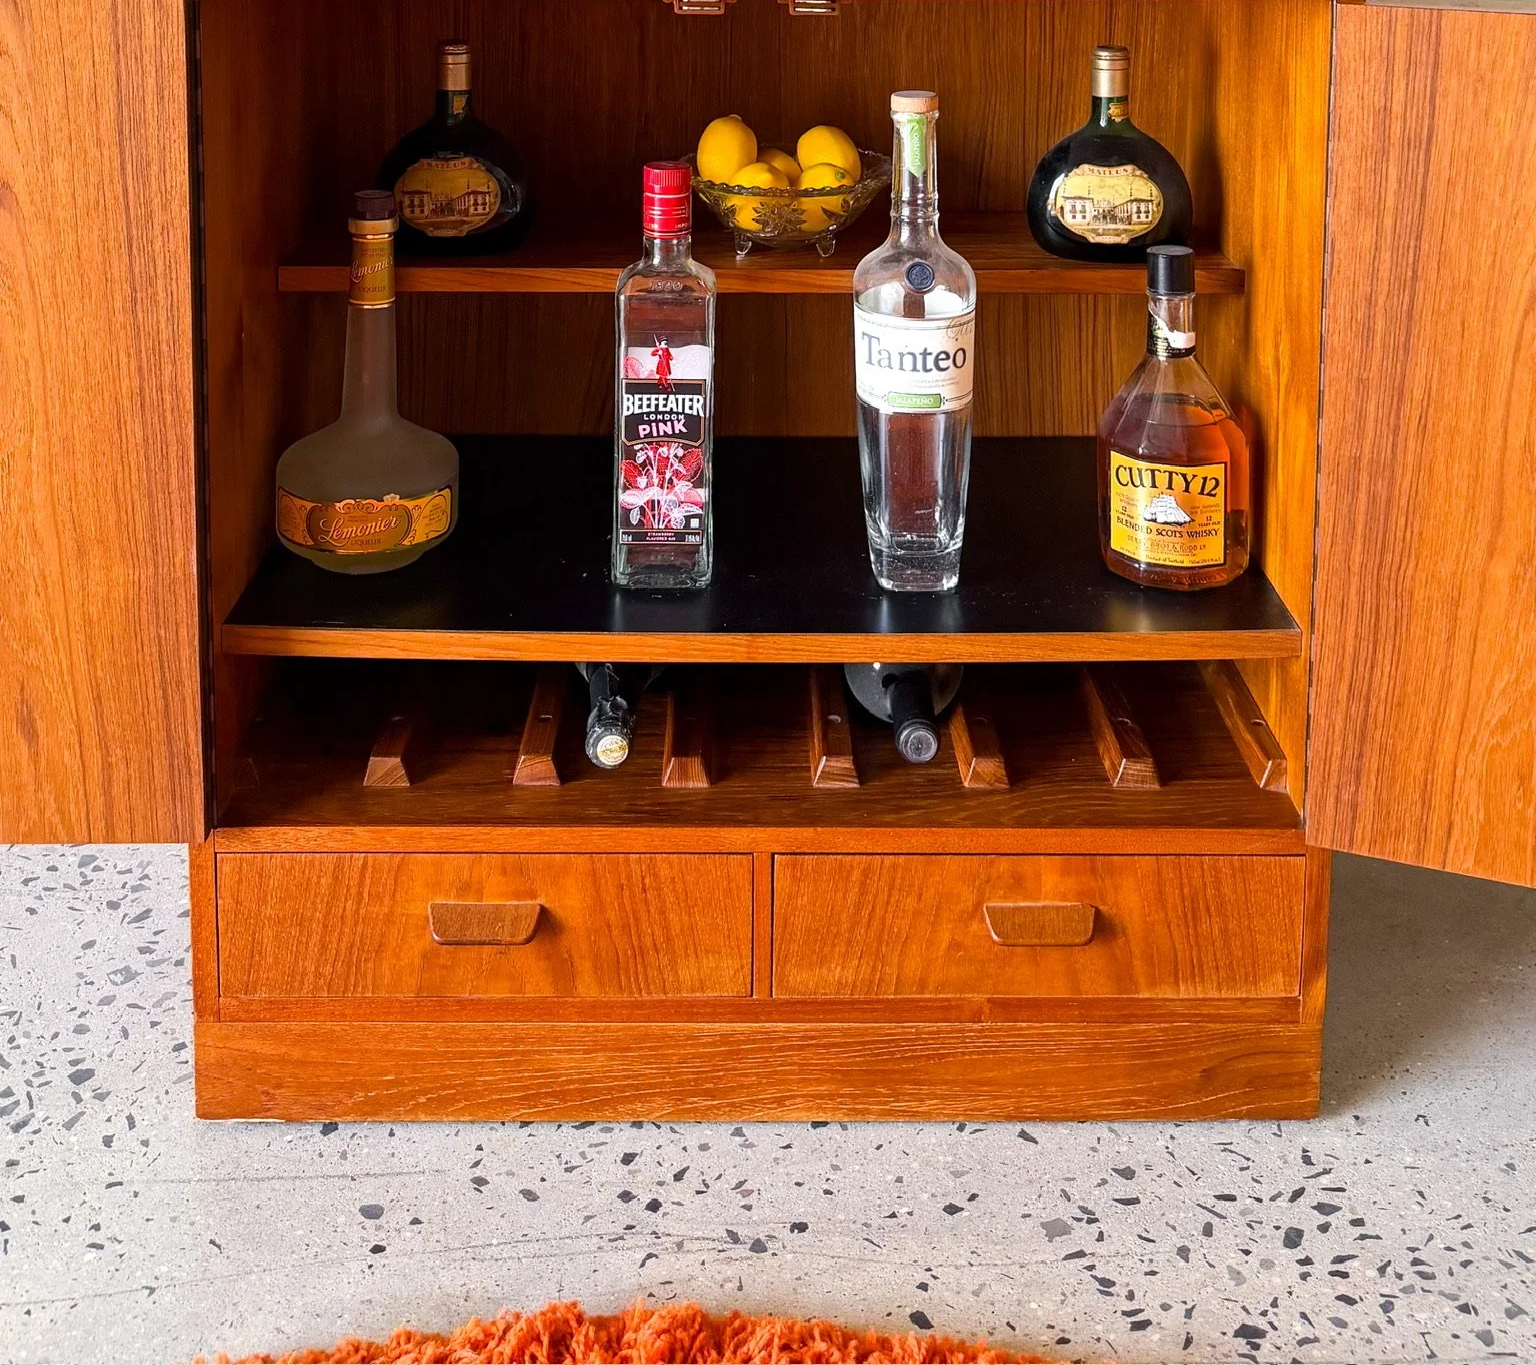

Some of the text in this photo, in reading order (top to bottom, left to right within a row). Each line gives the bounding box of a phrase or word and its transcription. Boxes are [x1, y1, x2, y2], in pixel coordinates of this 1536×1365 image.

[1087, 167, 1129, 176] MATEUS
[861, 331, 967, 373] Tanteo
[622, 394, 704, 418] BEEFEATER
[638, 418, 688, 439] PINK
[1115, 464, 1220, 498] CUTTY 12
[319, 515, 400, 548] Lemonier
[1116, 515, 1220, 539] BLENDED SCOTS WHISKY
